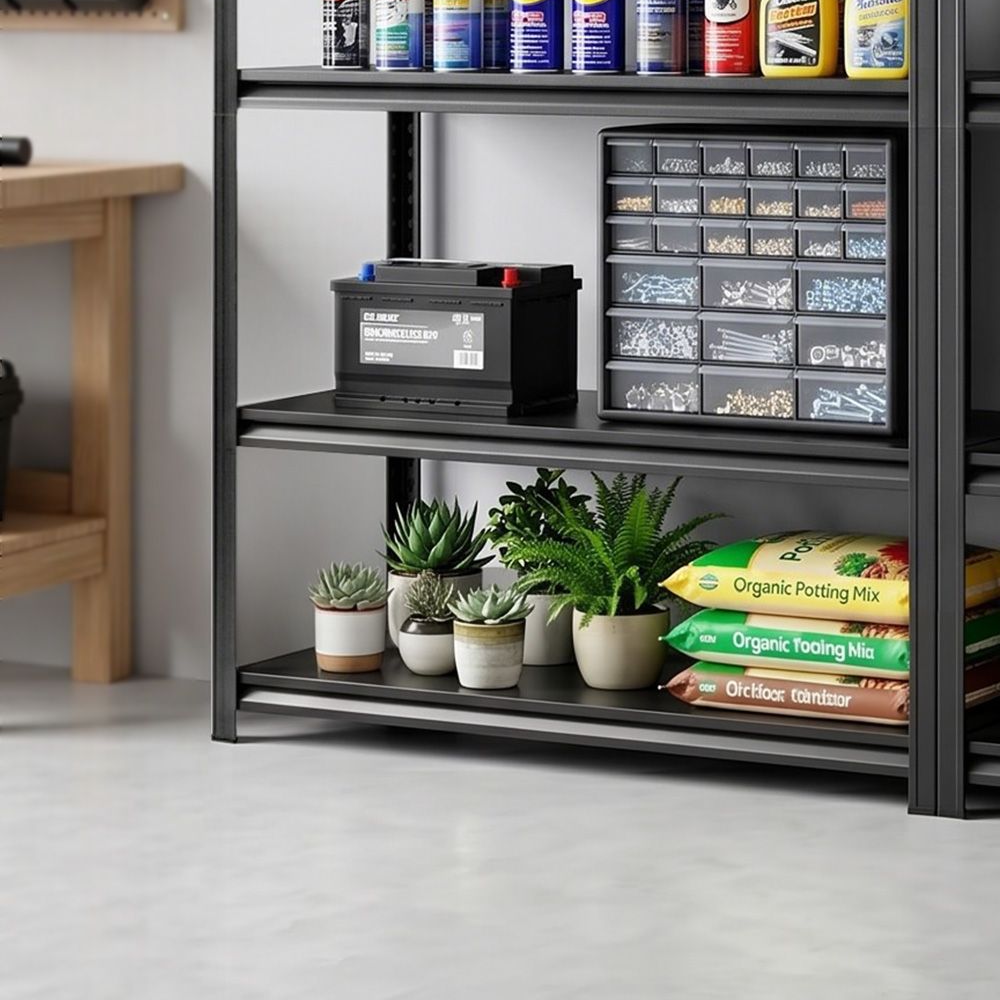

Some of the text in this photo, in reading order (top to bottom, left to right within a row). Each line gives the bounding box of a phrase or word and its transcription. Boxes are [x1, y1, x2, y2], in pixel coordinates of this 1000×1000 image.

[733, 576, 880, 604] Organic Potting Mix
[732, 631, 790, 655] Organic
